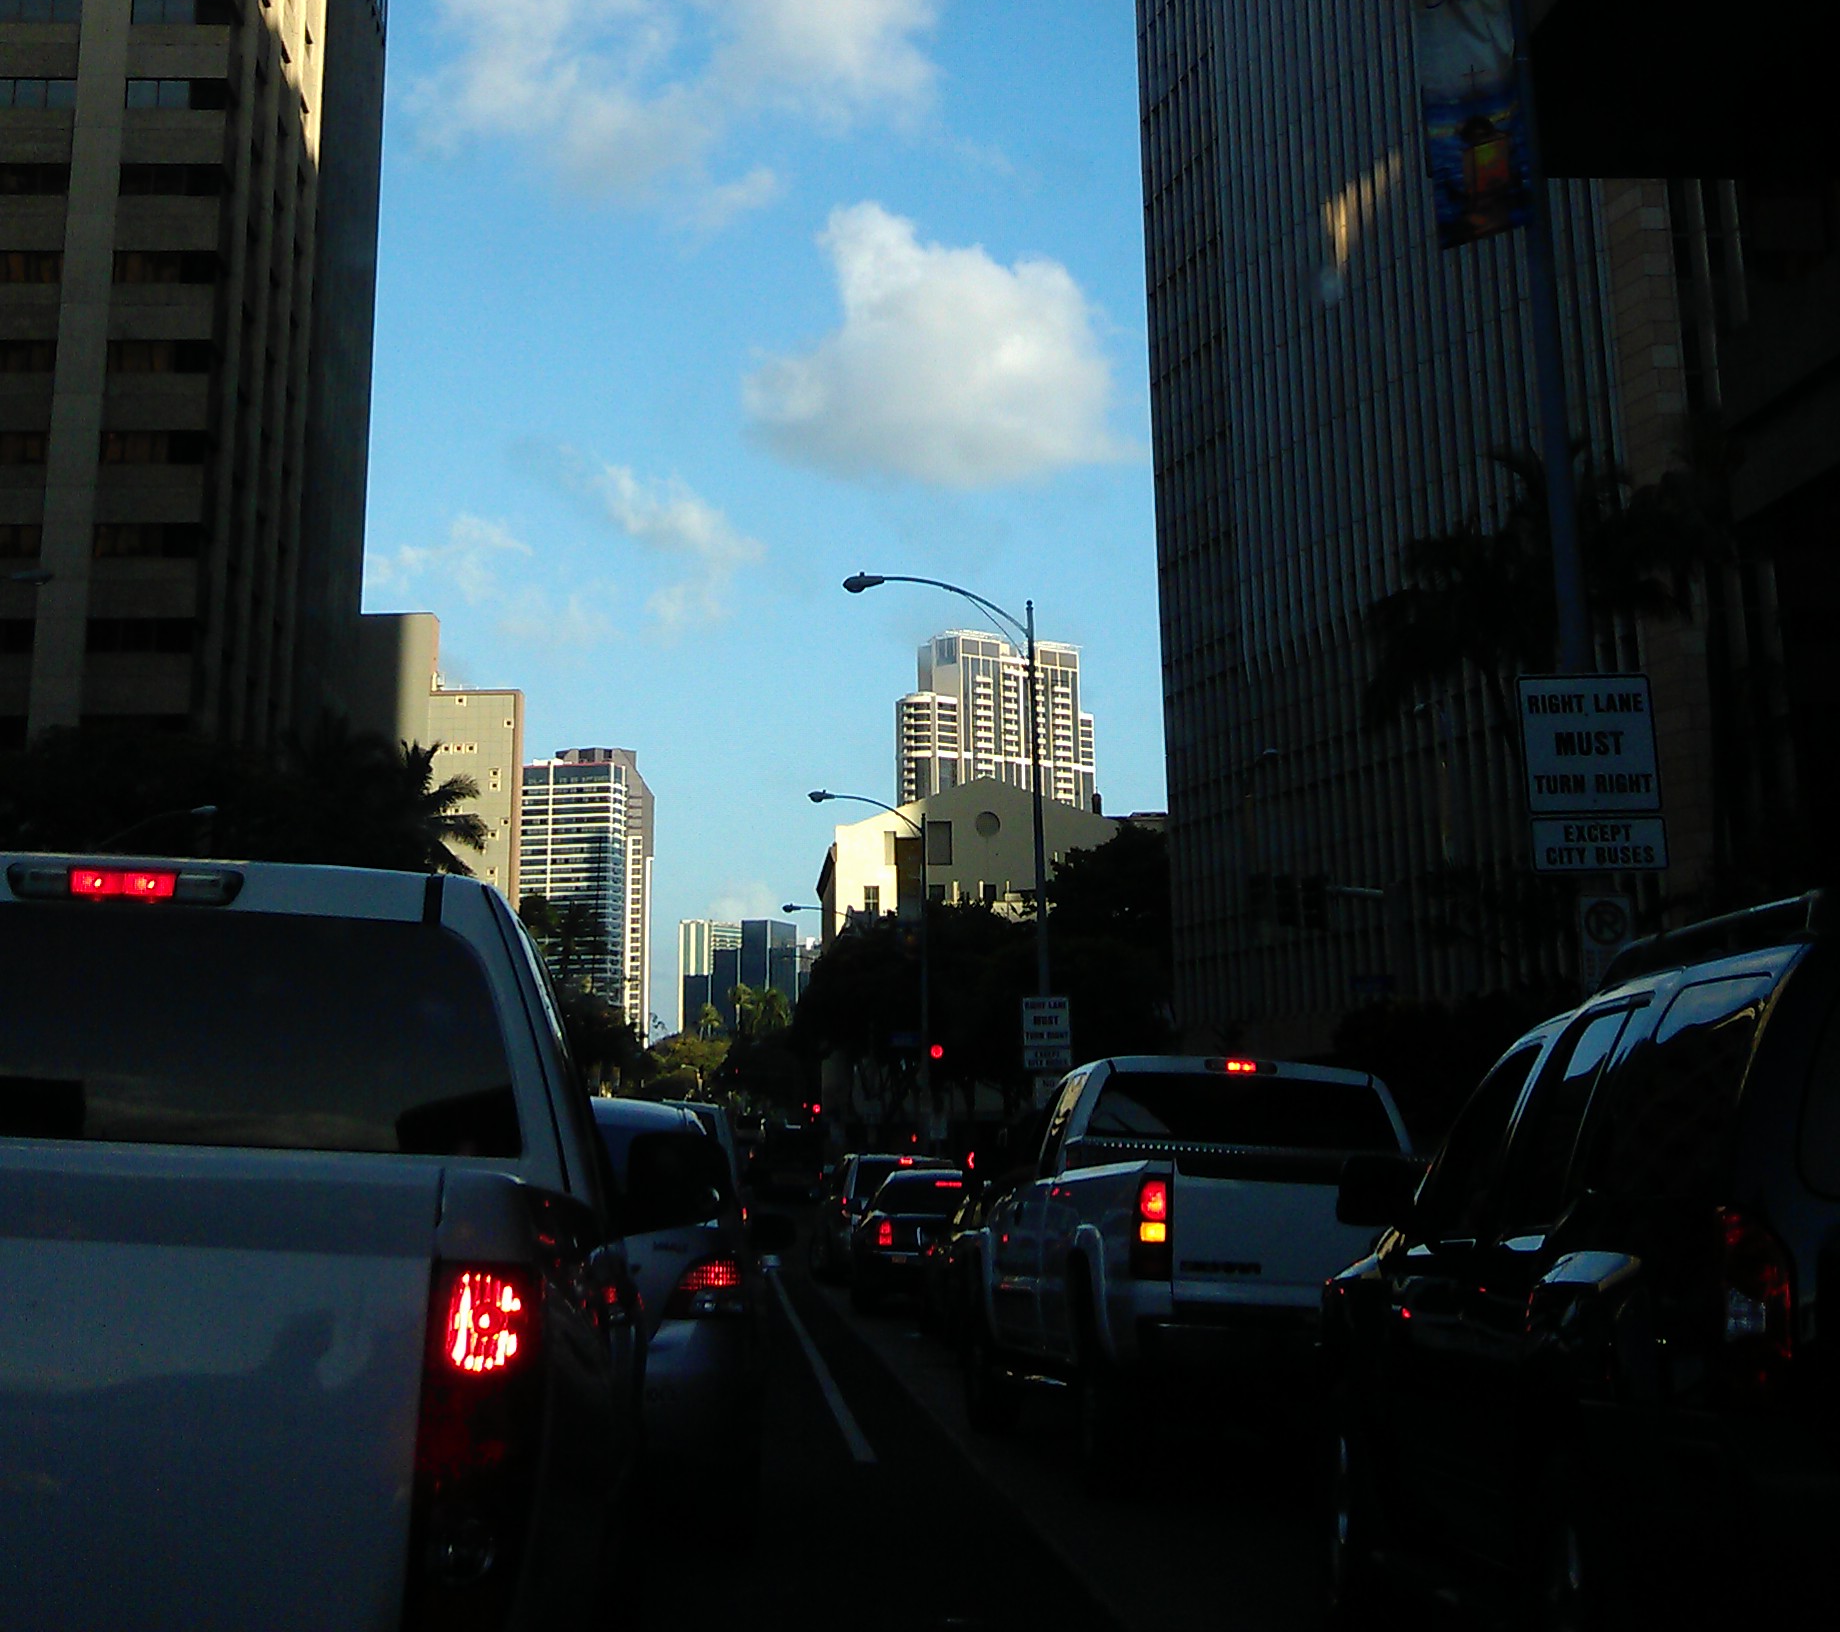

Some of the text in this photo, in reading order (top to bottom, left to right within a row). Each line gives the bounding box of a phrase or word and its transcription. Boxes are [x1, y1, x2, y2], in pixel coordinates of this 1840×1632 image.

[1527, 693, 1644, 714] RIGHT LANE
[1554, 731, 1624, 756] MUST
[1533, 773, 1653, 794] TURN RIGHT
[1563, 824, 1632, 843] EXCEPT
[1546, 846, 1655, 865] CITY BUSES
[1033, 1015, 1059, 1025] MUST
